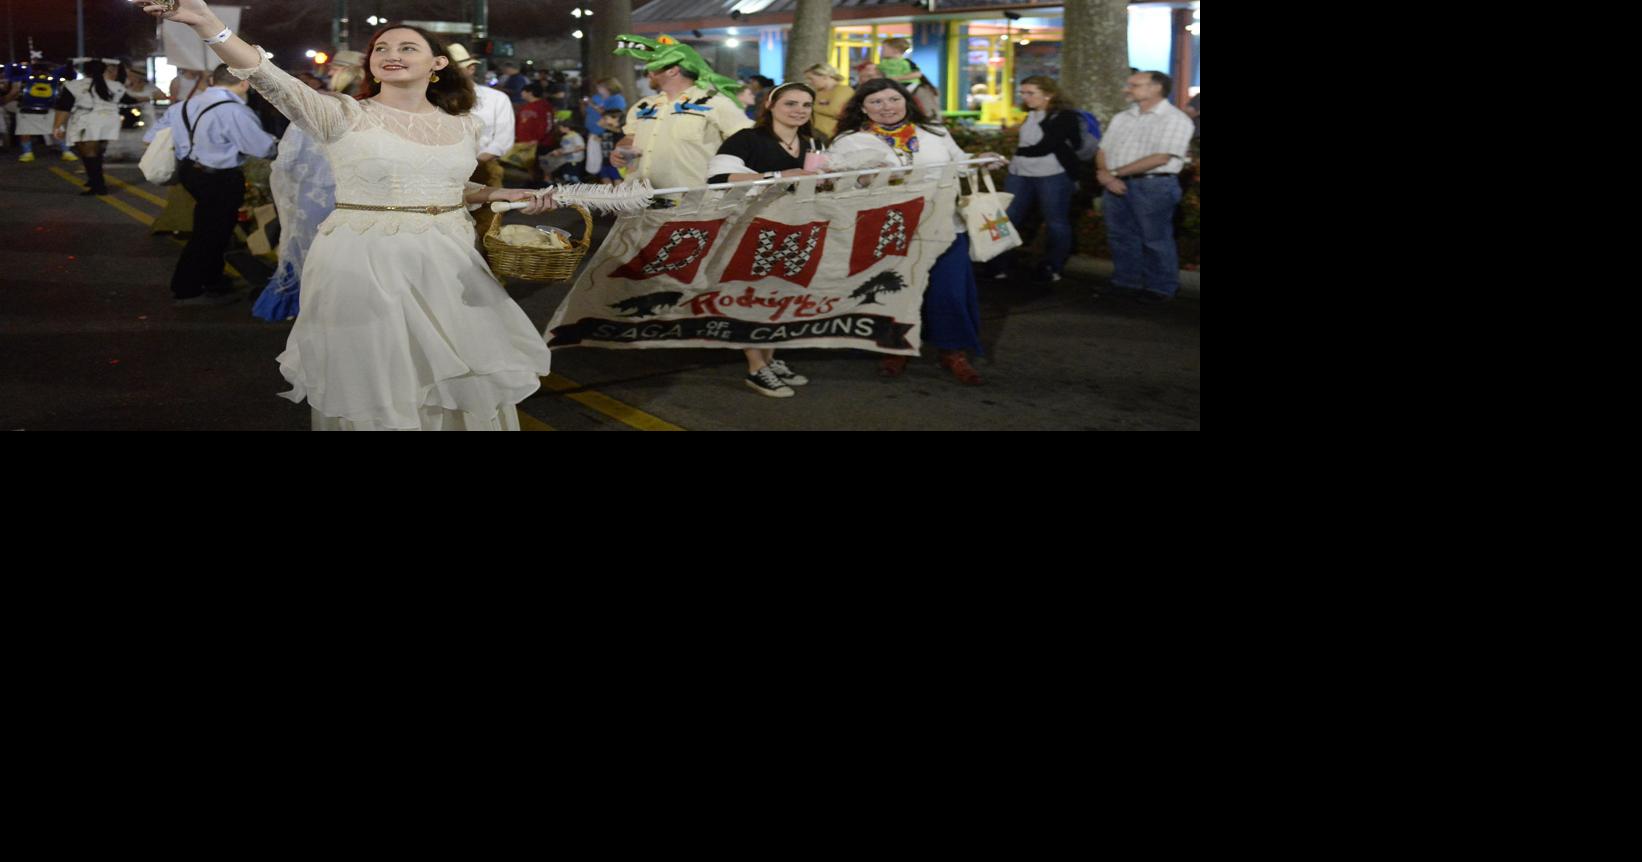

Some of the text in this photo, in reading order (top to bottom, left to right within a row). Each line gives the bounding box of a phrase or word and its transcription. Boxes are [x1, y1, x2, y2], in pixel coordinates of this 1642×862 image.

[592, 317, 875, 340] SAGA OF THE CAJUNS
